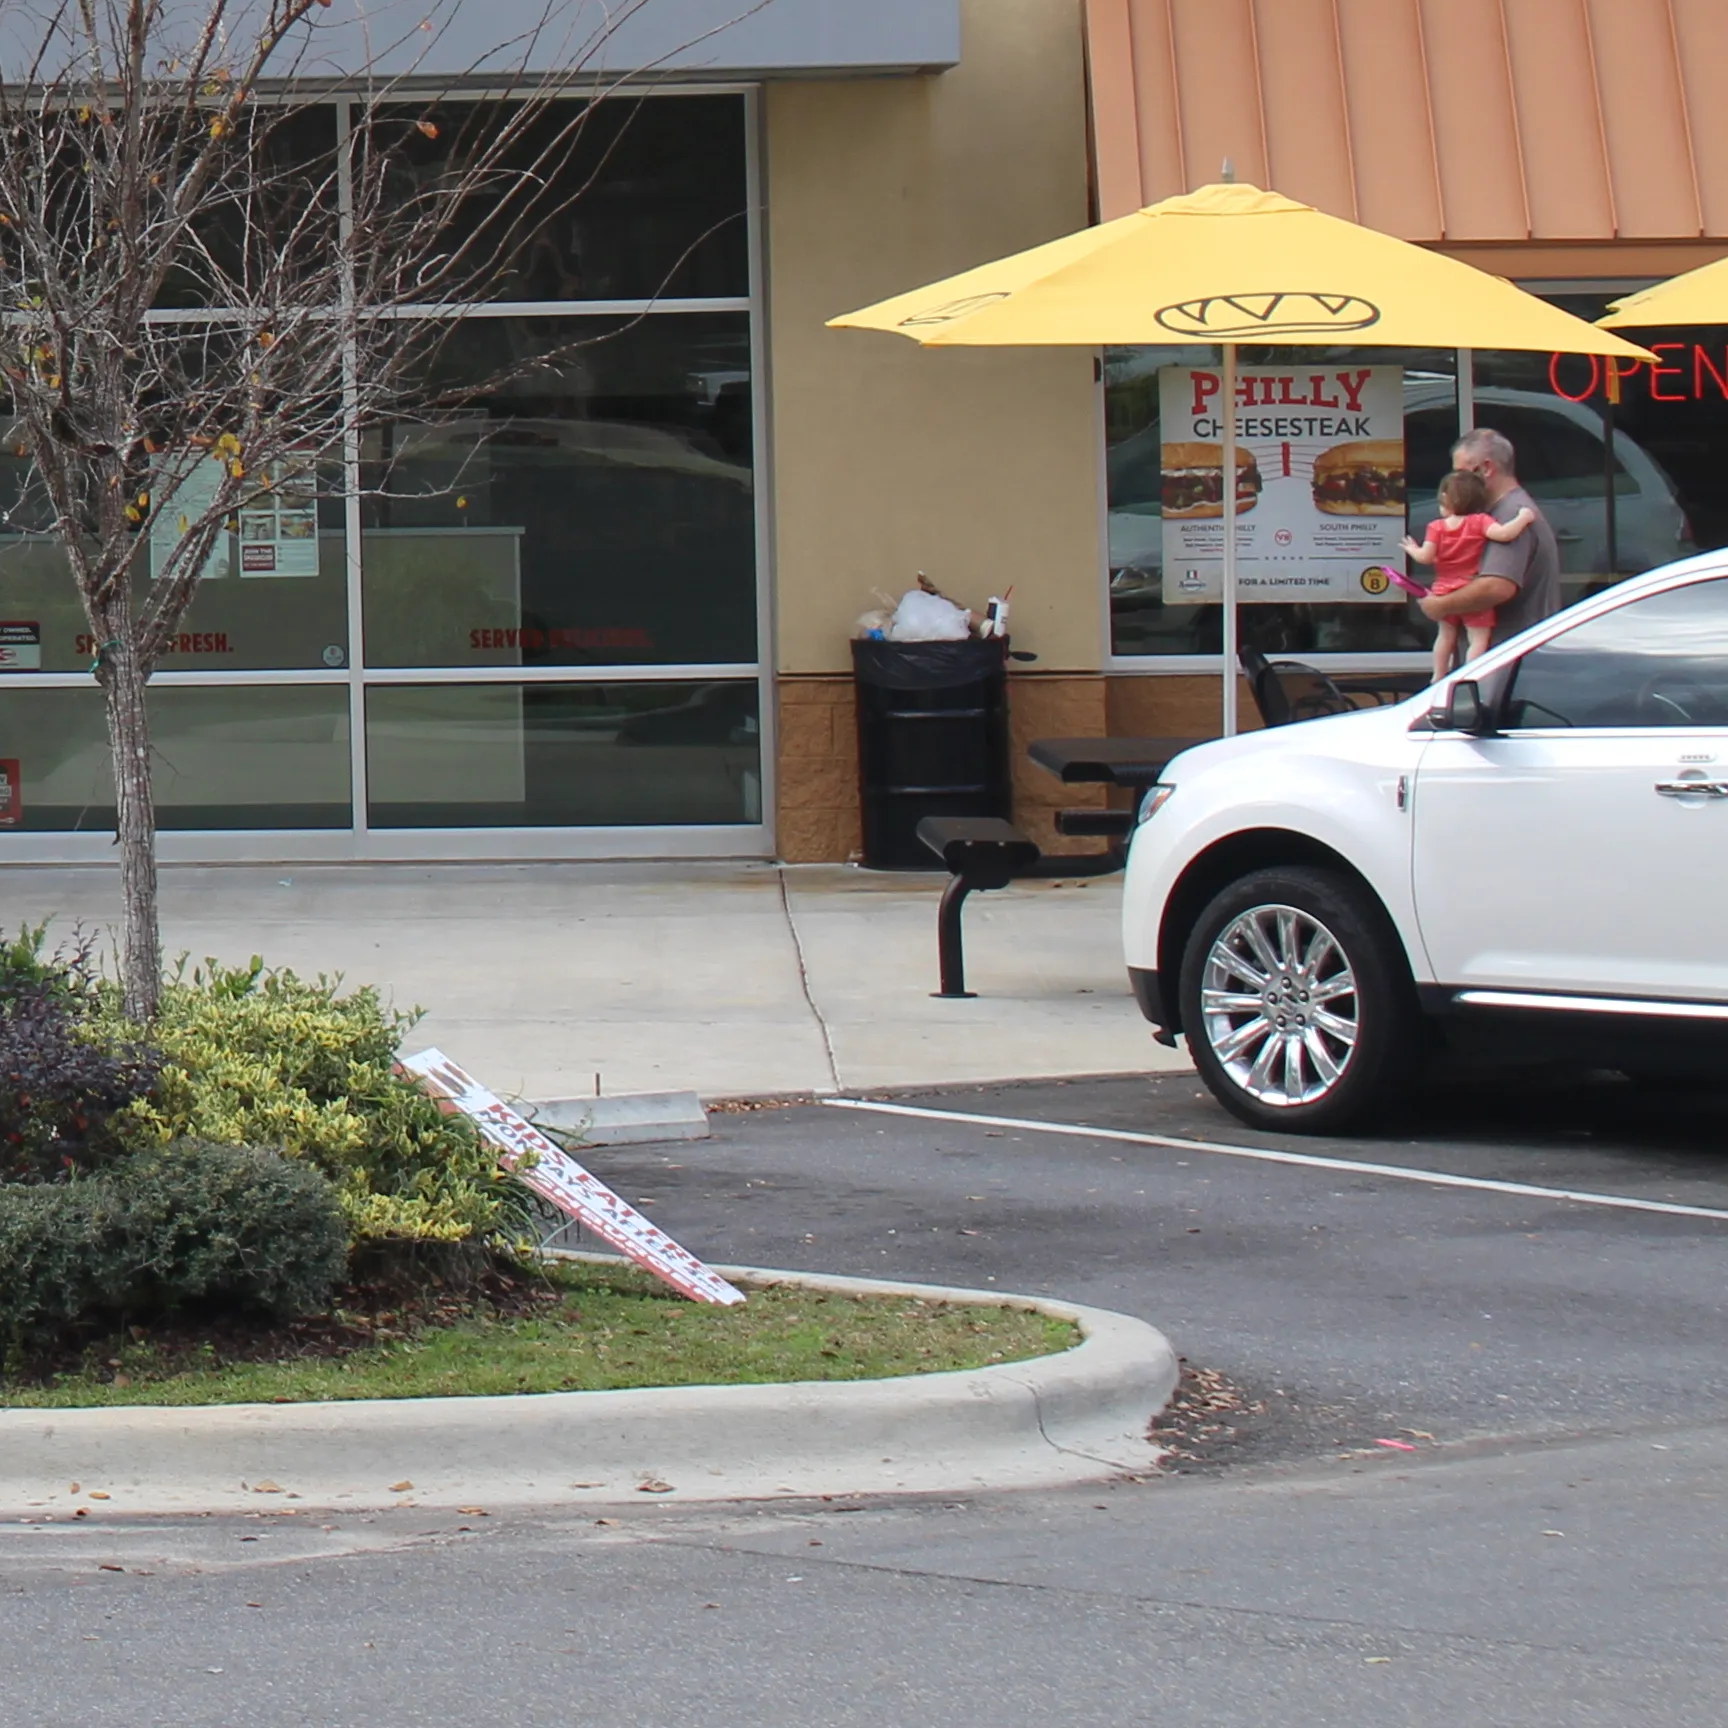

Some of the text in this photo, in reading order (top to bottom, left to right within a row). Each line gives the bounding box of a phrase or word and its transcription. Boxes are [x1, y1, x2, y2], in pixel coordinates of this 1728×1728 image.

[1238, 577, 1330, 586] FOR A LIMITED TIME
[487, 1103, 571, 1167] KIDS
[575, 1173, 639, 1217] EAT
[646, 1229, 726, 1288] FREE
